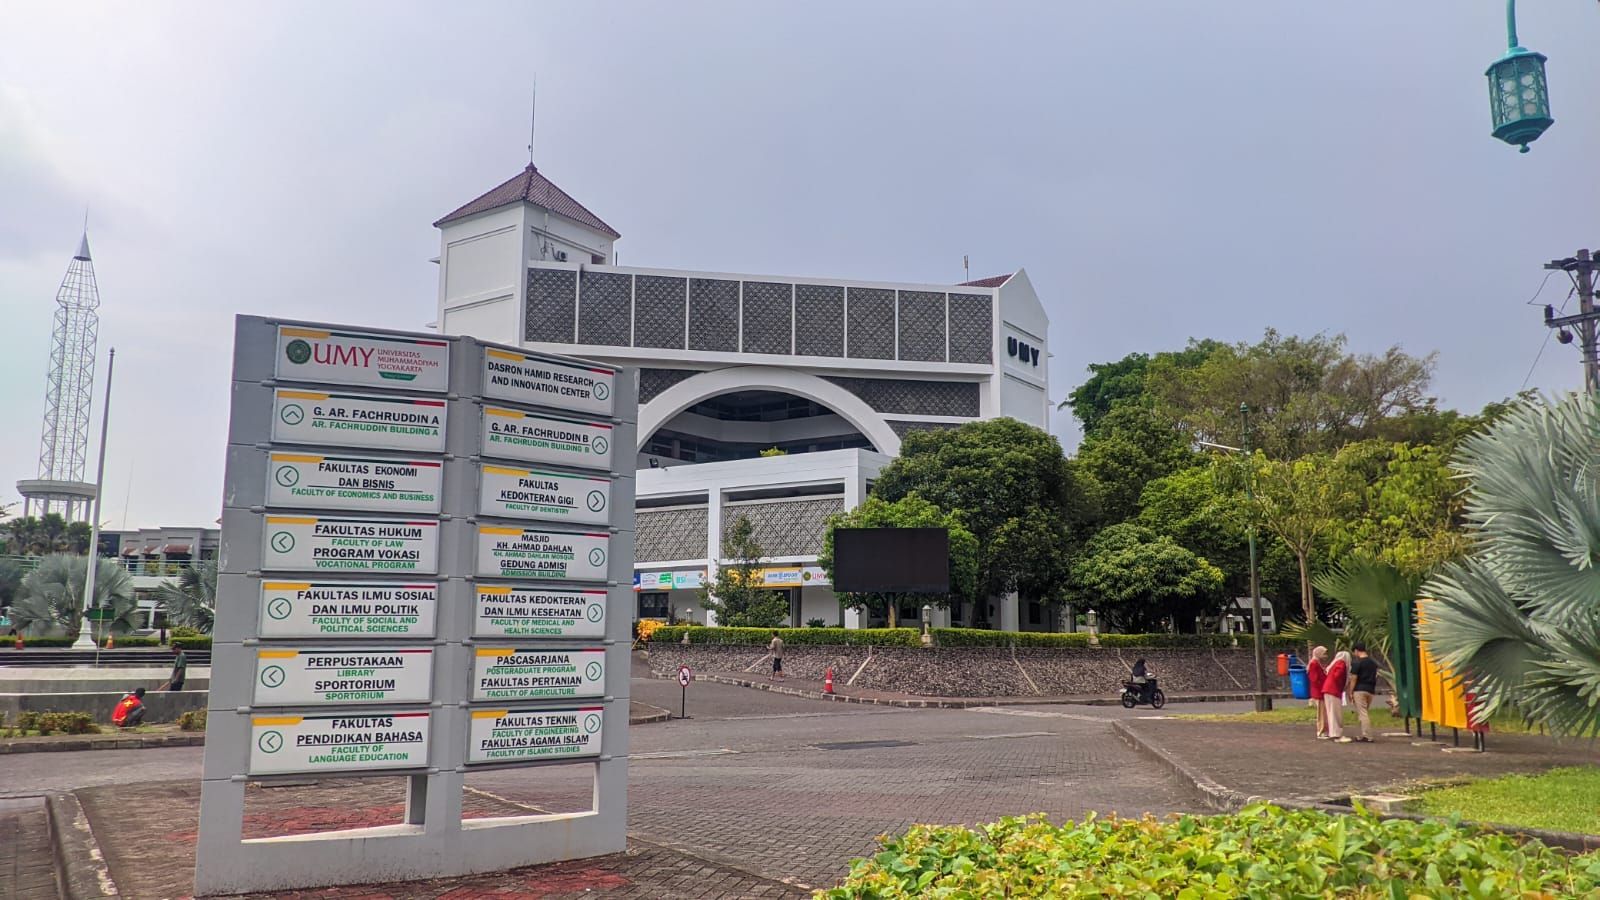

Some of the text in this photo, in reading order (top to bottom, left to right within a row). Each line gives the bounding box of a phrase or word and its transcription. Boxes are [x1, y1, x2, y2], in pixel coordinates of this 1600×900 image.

[314, 343, 375, 368] UMY
[378, 349, 421, 358] UNIVERSITAS
[1008, 336, 1039, 368] UMY
[377, 356, 438, 367] MUHAMMADIYAH
[377, 364, 423, 372] YOGYAKARTA
[488, 362, 594, 387] DASRON HAMID RESEARCH
[492, 376, 590, 398] AND INNOVATION CENTER
[314, 407, 439, 425] G. AR. FACHRUDDIN A
[312, 421, 326, 429] AR.
[330, 421, 387, 433] FACHRUDDIN
[390, 426, 430, 436] BUILDING
[492, 422, 501, 432] G.
[504, 424, 519, 434] AR.
[522, 427, 580, 442] FACHRUDDIN
[490, 434, 501, 442] AR.
[504, 436, 549, 448] FACHRUDDIN
[551, 443, 582, 452] BUILDING
[319, 462, 417, 477] FAKULTAS EKONOMI
[339, 477, 395, 489] DAN BISNIS
[519, 479, 559, 490] FAKULTAS
[292, 488, 434, 501] FACULTY OF ECONOMICS AND BUSINESS
[501, 490, 574, 504] KEDOKTERAN GIGI
[540, 506, 569, 514] DENTISTRY
[315, 525, 422, 537] FAKULTAS HUKUM
[332, 538, 370, 546] FACULTY
[496, 542, 510, 550] KH.
[543, 544, 572, 552] DAHLAN
[314, 548, 419, 559] PROGRAM VOKASI
[372, 561, 415, 569] PROGRAM
[501, 560, 567, 569] GEDUNG ADMISI
[297, 591, 435, 600] FAKULTAS ILMU SOSIAL
[480, 594, 586, 605] FAKULTAS KEDOKTERAN
[313, 605, 418, 614] DAN ILMU POLITIK
[484, 607, 582, 617] DAN ILMU KESEHATAN
[308, 657, 403, 667] PERPUSTAKAAN
[497, 655, 570, 665] PASCASARJANA
[337, 669, 375, 677] LIBRARY
[486, 666, 541, 674] POSTGRADUATE
[315, 680, 395, 690] SPORTORIUM
[481, 676, 582, 687] FAKULTAS PERTANIAN
[325, 692, 384, 700] SPORTORIUM
[531, 688, 575, 696] AGRICULTURE
[332, 718, 393, 729] FAKULTAS
[496, 716, 577, 727] FAKULTAS TEKNIK
[296, 731, 423, 745] PENDIDIKAN BAHASA
[492, 727, 579, 738] FACULTY OF ENGINEERING
[482, 735, 589, 748] FAKULTAS AGAMA ISLAM
[331, 746, 371, 754] FACULTY
[487, 749, 516, 758] FACULTY
[517, 748, 526, 756] OF
[309, 753, 408, 763] LANGUAGE EDUCATION
